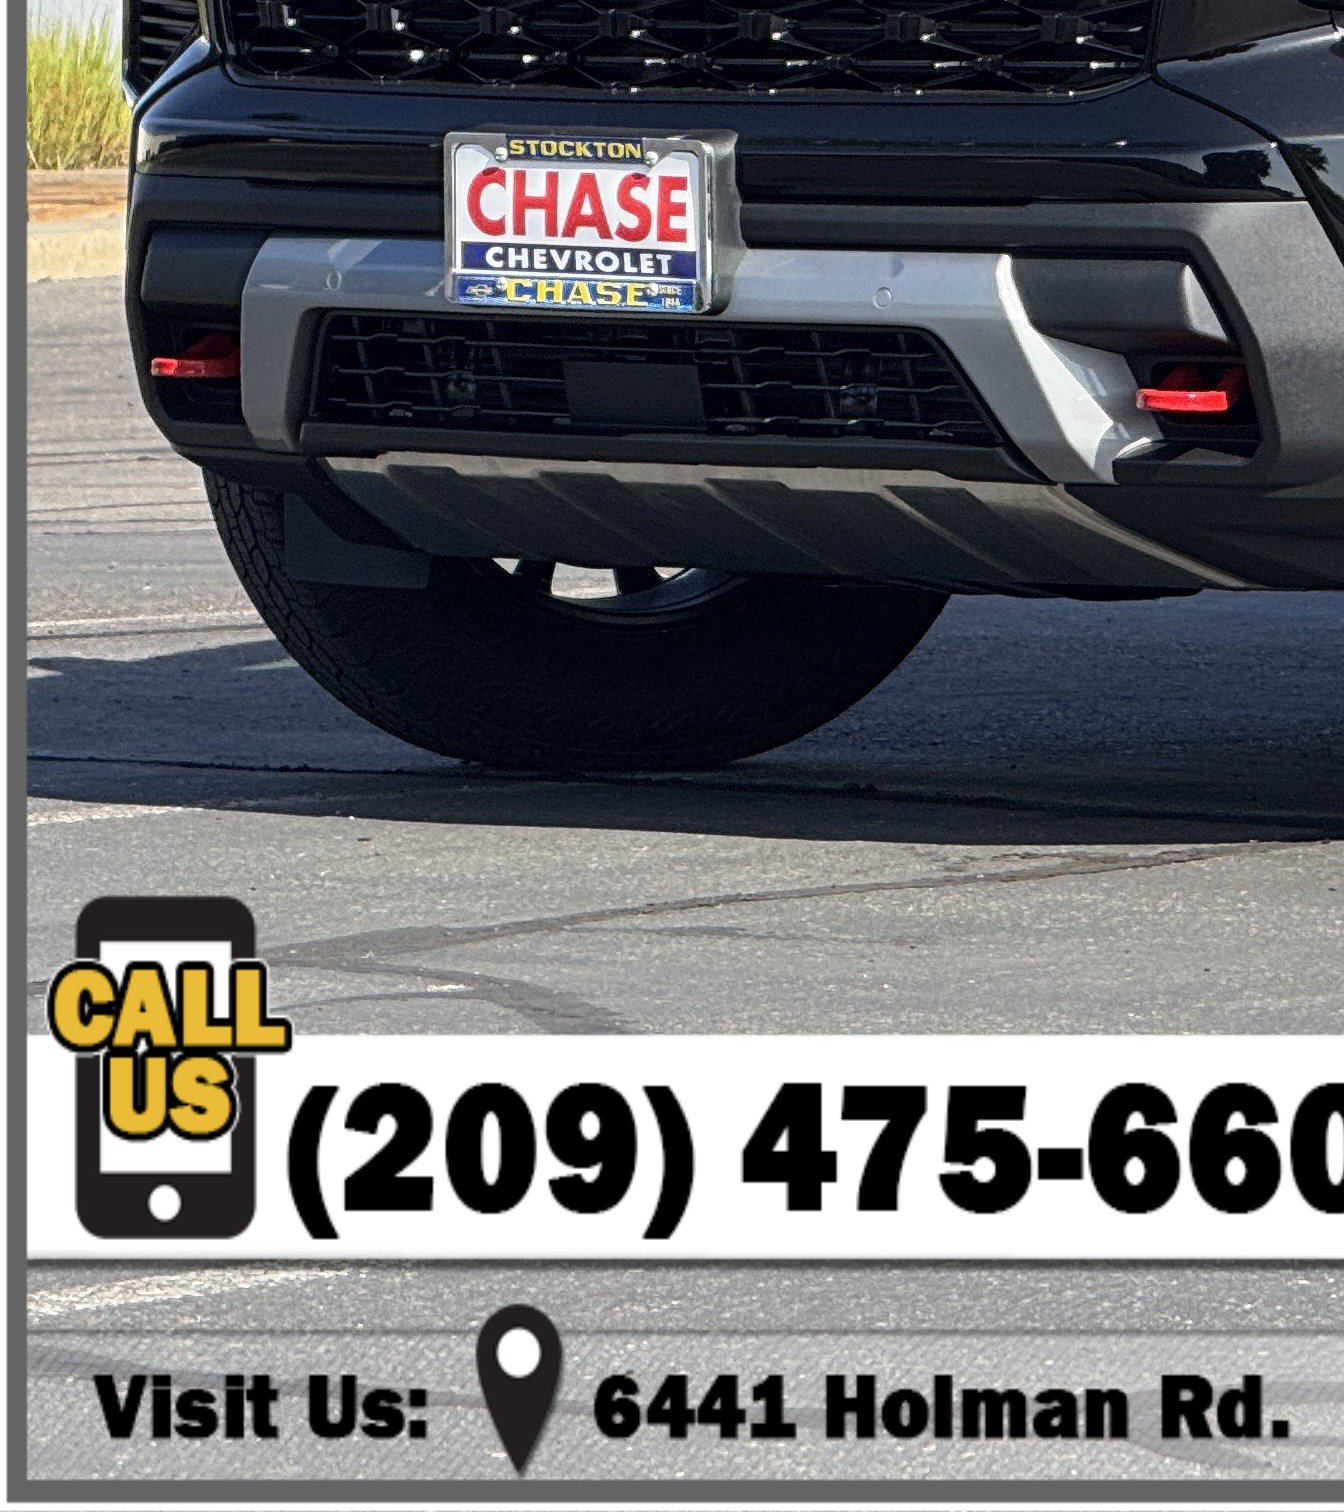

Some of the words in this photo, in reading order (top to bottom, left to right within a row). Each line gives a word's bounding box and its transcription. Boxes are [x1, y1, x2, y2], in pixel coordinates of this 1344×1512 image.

[508, 139, 642, 159] STOCKTON
[466, 167, 688, 244] CHASE
[485, 246, 672, 275] CHEVROLET
[505, 279, 649, 307] CHASE
